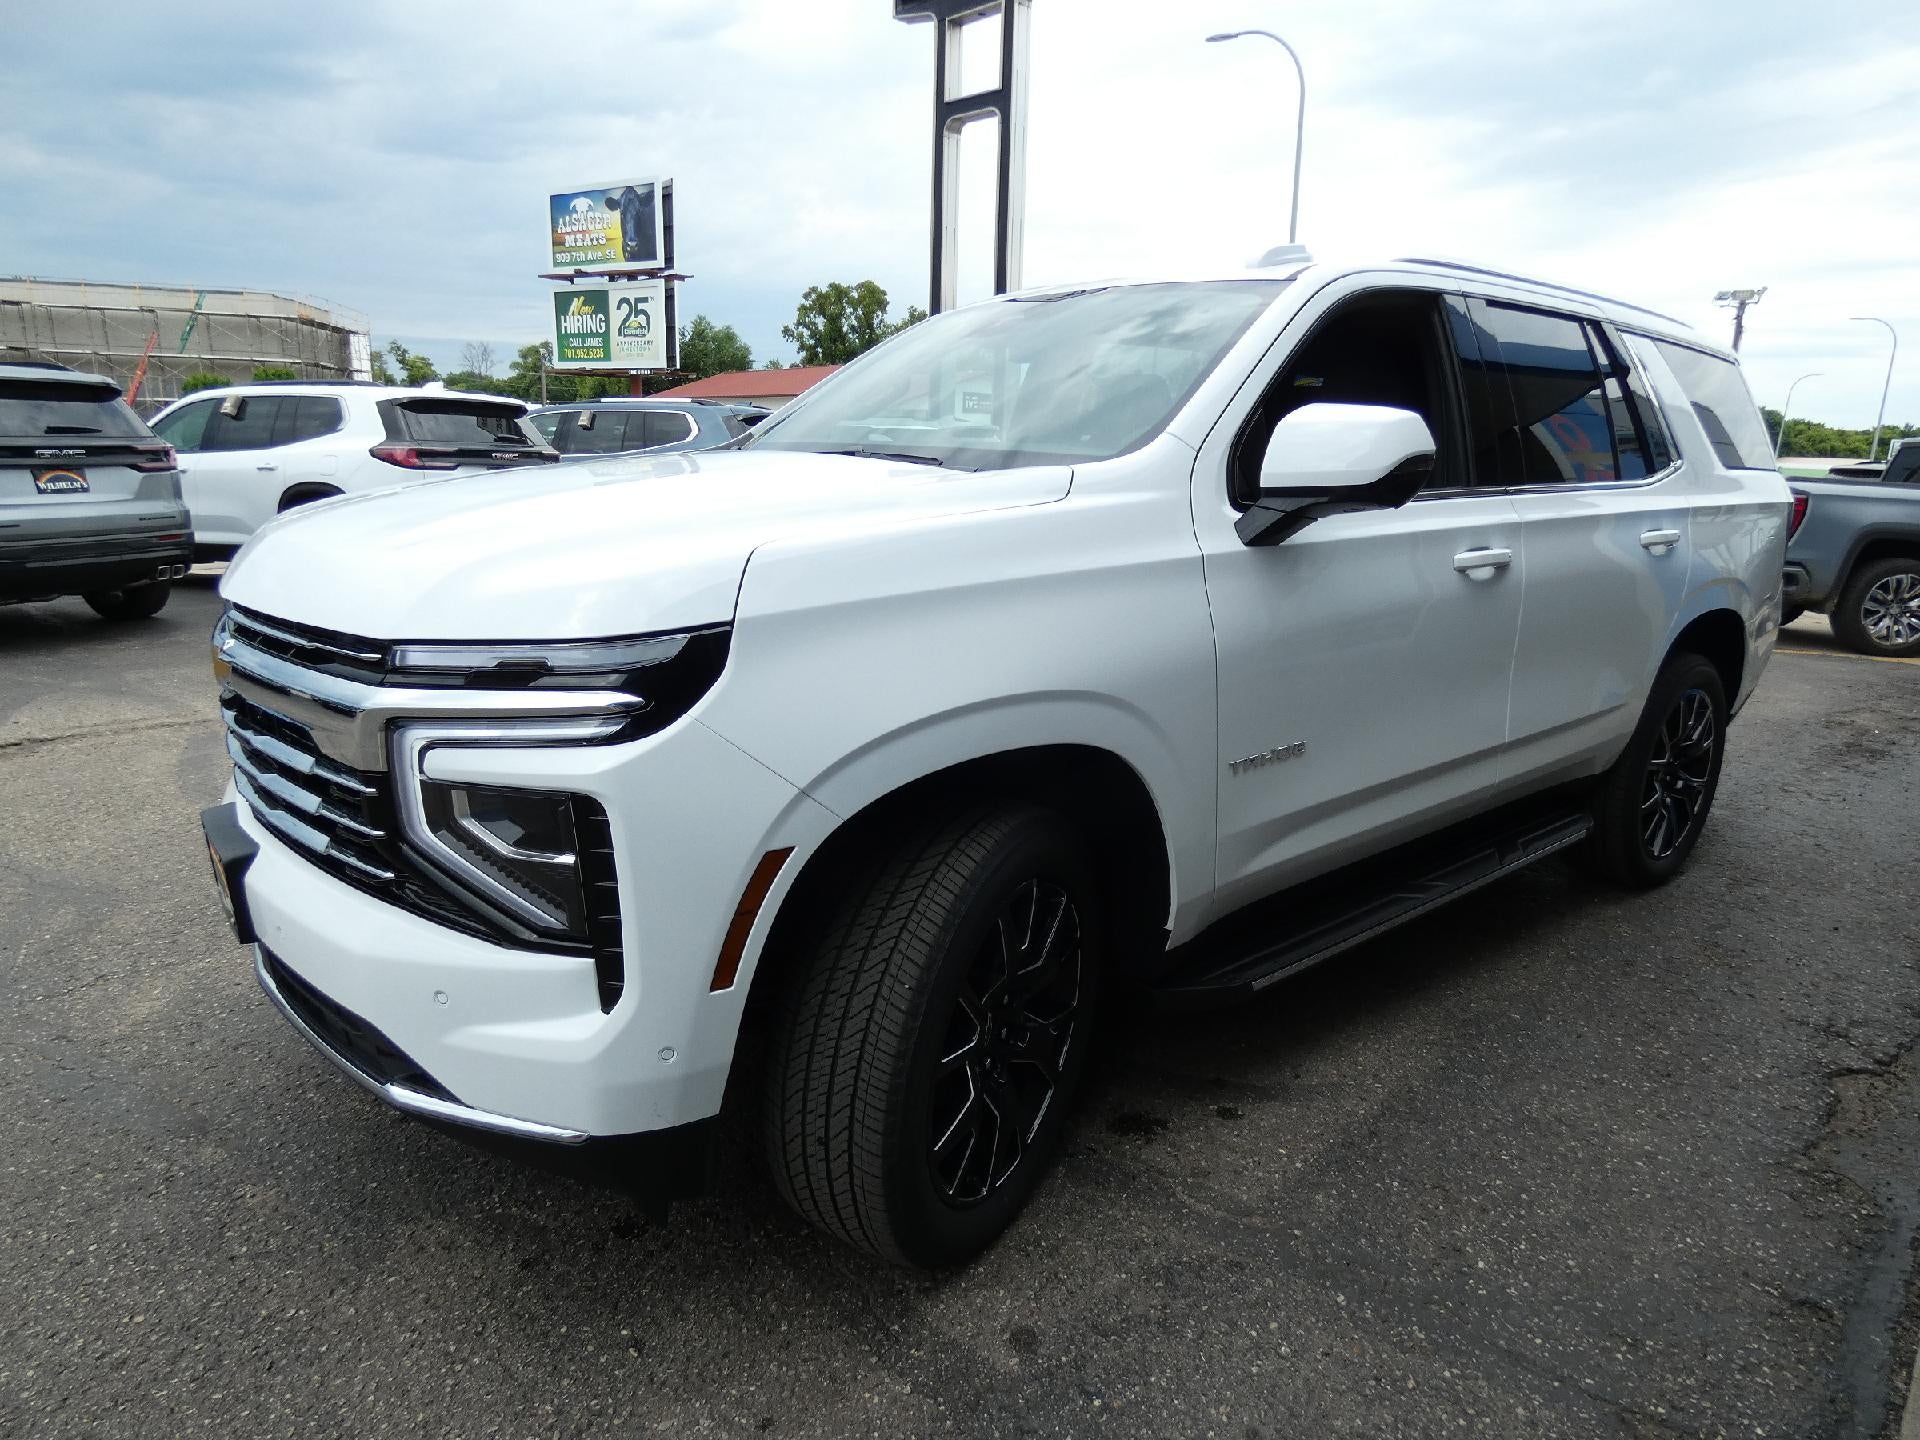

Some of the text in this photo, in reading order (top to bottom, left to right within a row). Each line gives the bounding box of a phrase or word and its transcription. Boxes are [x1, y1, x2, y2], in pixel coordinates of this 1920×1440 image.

[557, 211, 611, 233] ALSAGER
[565, 233, 606, 247] MEATS
[571, 251, 585, 262] 7th
[605, 249, 616, 259] SE
[568, 296, 594, 316] Now
[561, 314, 606, 334] HIRING
[616, 297, 650, 337] 25
[570, 337, 603, 347] CALL JAMES
[36, 449, 86, 458] GMC
